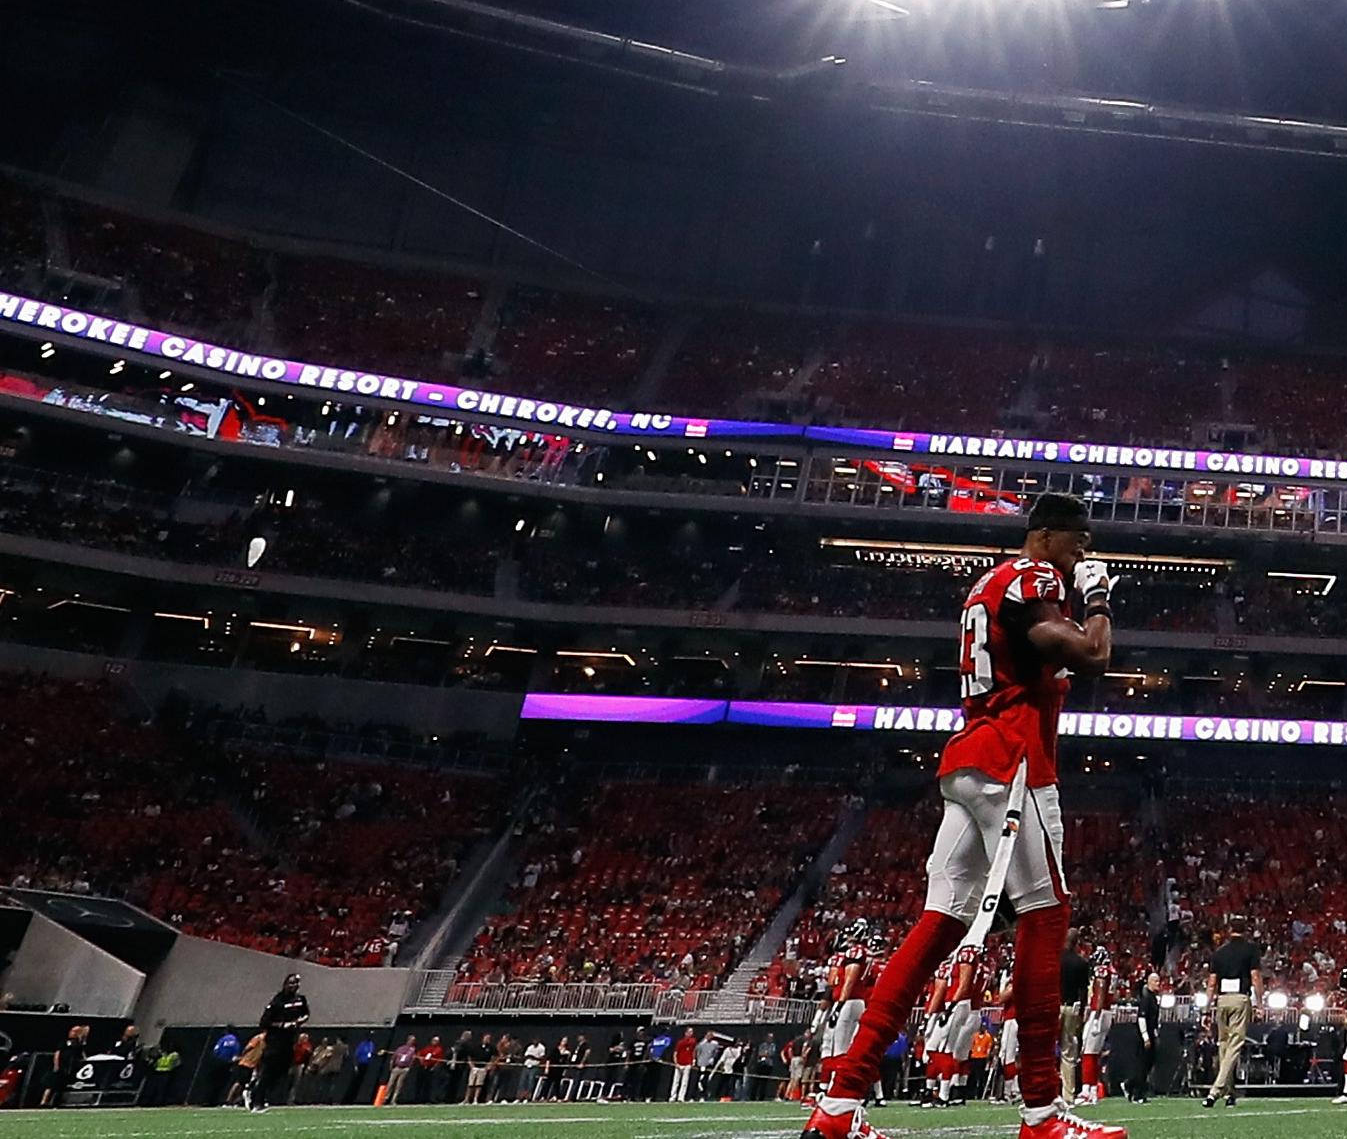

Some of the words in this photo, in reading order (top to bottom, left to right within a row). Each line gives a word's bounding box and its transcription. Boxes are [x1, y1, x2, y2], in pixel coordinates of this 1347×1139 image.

[0, 294, 149, 349] HEROKEE
[160, 336, 287, 380] CASINO
[298, 365, 418, 400] RESORT
[457, 390, 617, 430] CHEROKEE,
[631, 413, 672, 429] NC
[929, 435, 1058, 460] HARRAH'S
[1069, 444, 1196, 469] CHEROKEE
[1206, 453, 1300, 476] CASINO
[960, 603, 993, 699] 3
[1057, 713, 1183, 738] HEROKEE
[1195, 717, 1301, 743] CASINO
[982, 894, 998, 912] G
